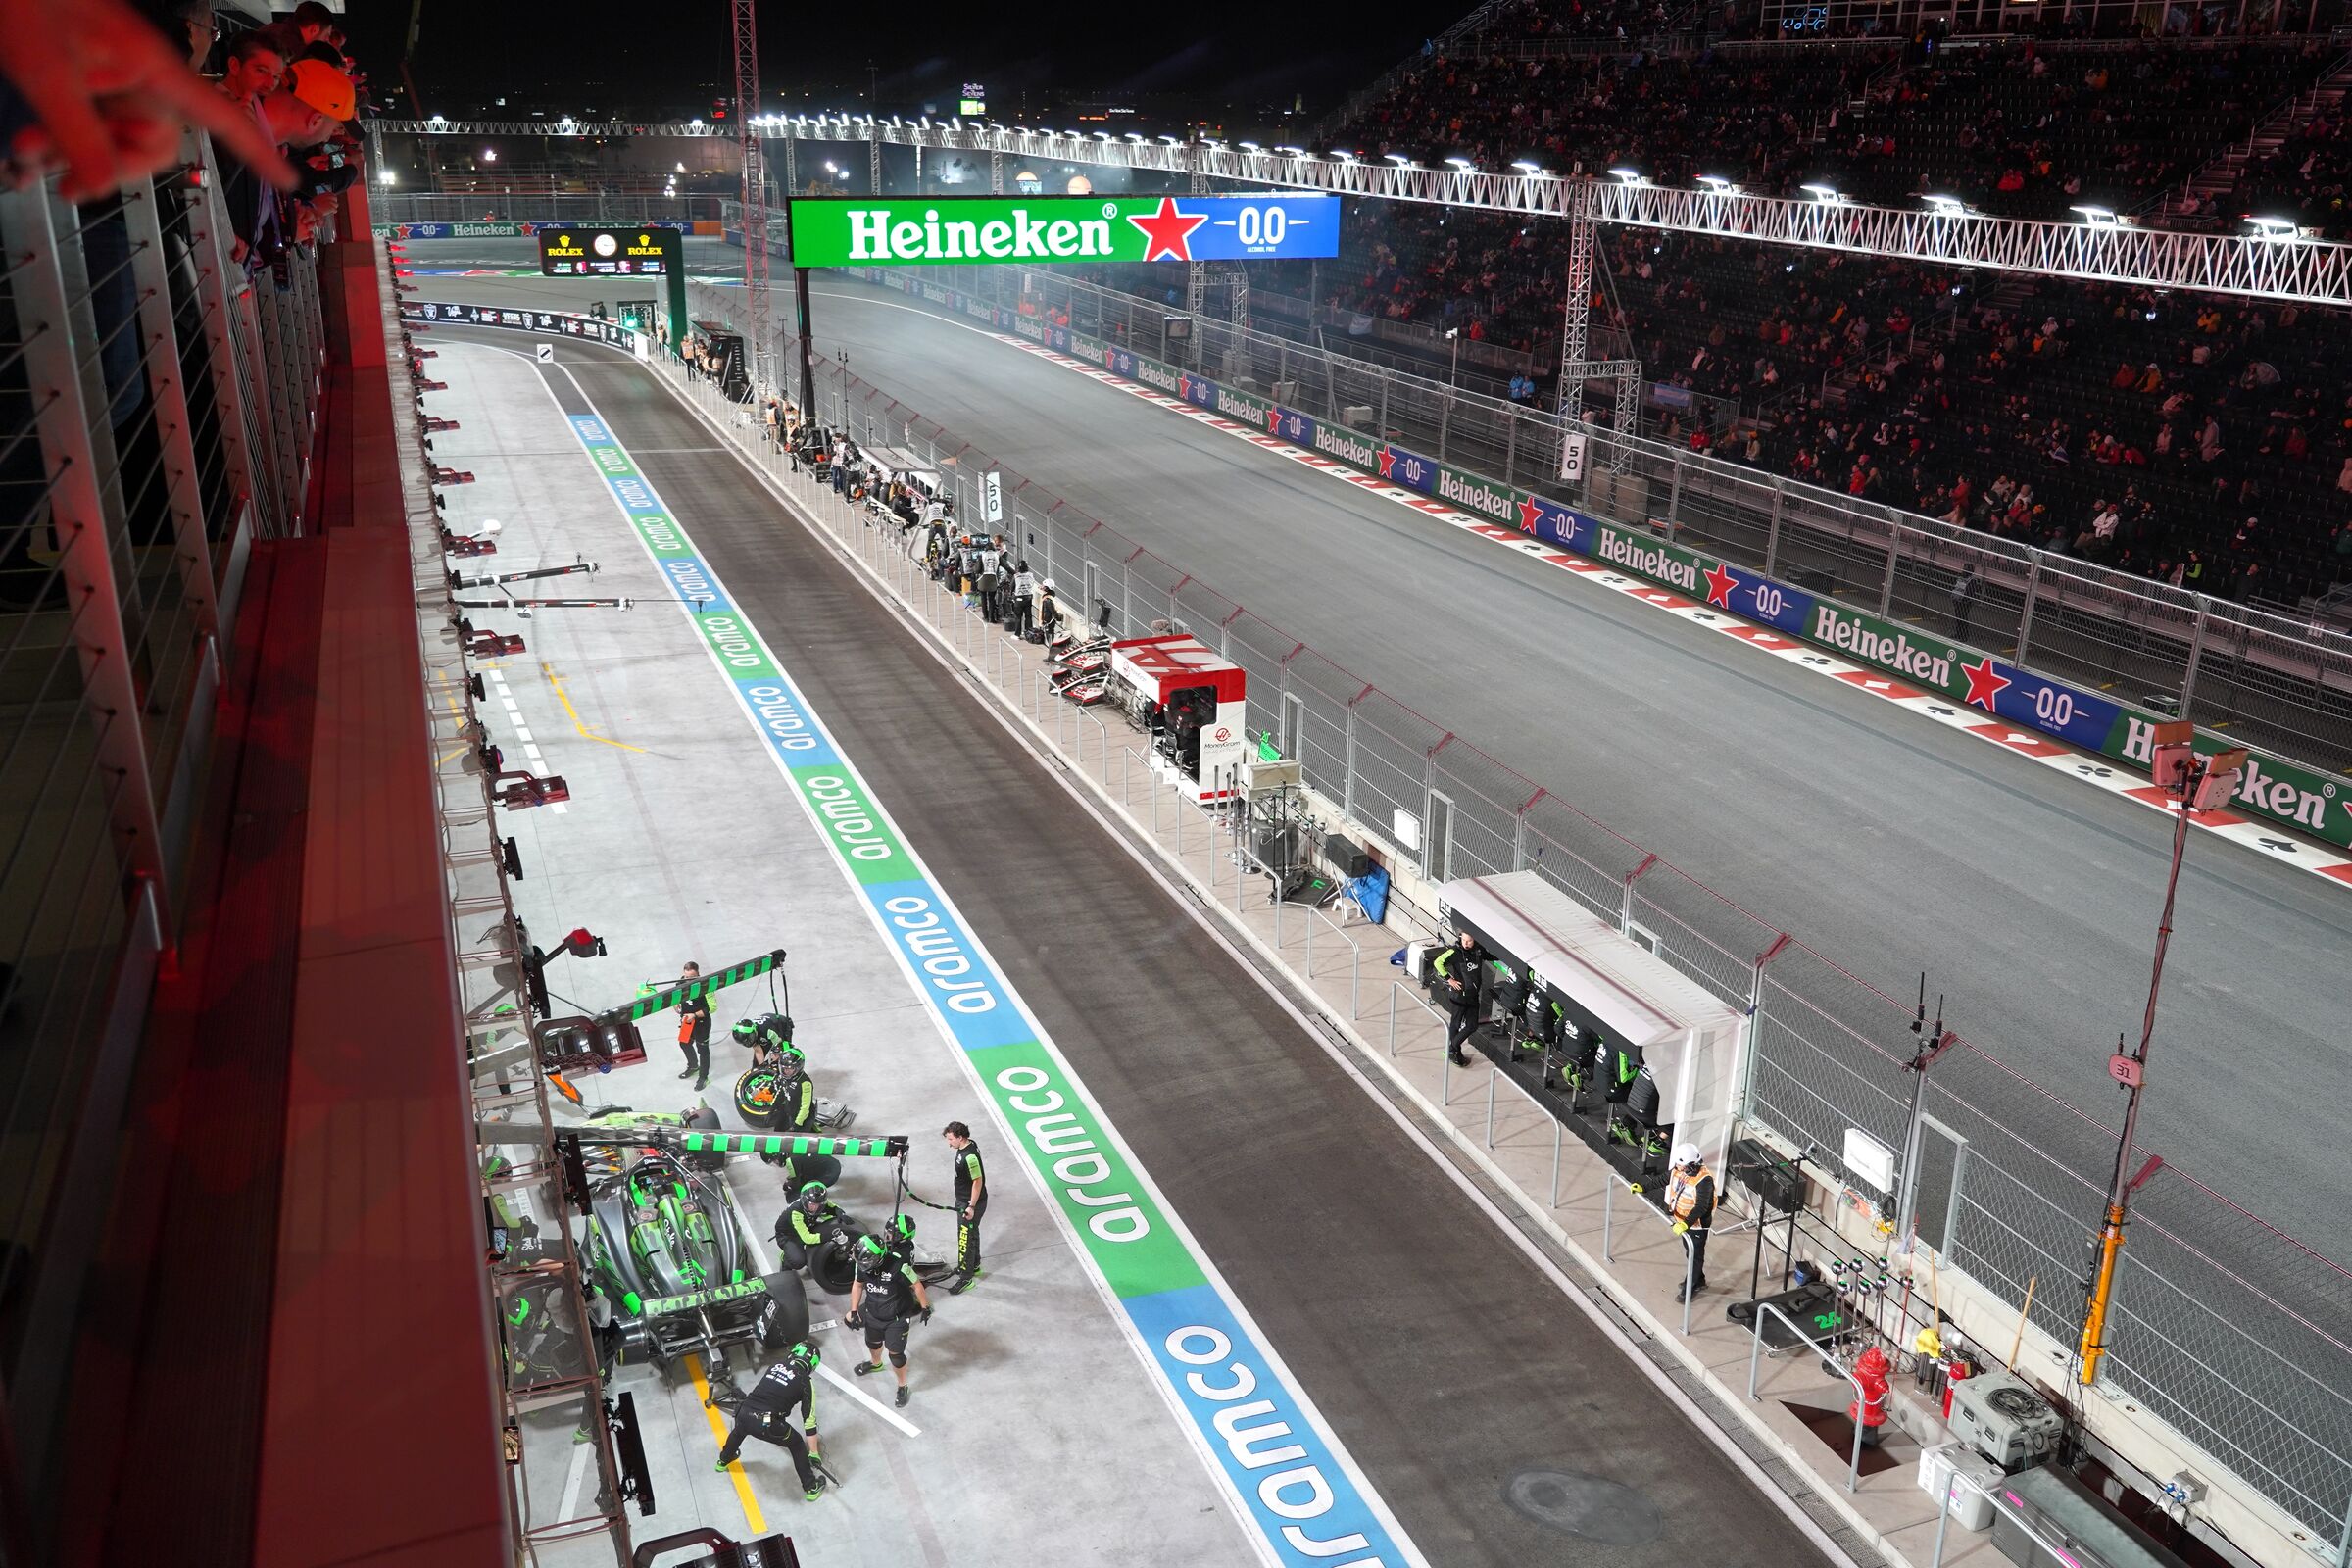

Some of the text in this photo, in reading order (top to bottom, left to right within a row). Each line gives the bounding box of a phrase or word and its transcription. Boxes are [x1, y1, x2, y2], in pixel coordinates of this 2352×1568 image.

[453, 224, 515, 237] Heineken
[847, 206, 1286, 259] Heineken 0.0
[547, 248, 584, 257] ROLEX
[627, 247, 663, 256] ROLEX
[1014, 316, 1043, 341] Heineken
[1071, 335, 1103, 365] Heineken
[1138, 360, 1207, 400] Heineken 0.0
[1218, 390, 1301, 436] Heineken 0.0
[595, 448, 628, 472] aramco
[1315, 424, 1420, 482] Heineken 0.0
[1567, 446, 1580, 470] 50
[614, 479, 652, 508] aramco
[989, 484, 999, 512] 50
[1439, 470, 1575, 539] Heineken 0.0
[639, 517, 681, 550] aramco
[667, 562, 716, 603] aramco
[1599, 527, 1782, 616] Heineken 0.0
[704, 617, 761, 667] aramco
[1814, 605, 2073, 725] Heineken 0.0
[749, 687, 817, 751] aramco
[806, 775, 893, 861] aramco
[885, 896, 997, 1014] aramco
[2117, 1063, 2131, 1079] 31
[996, 1066, 1151, 1243] aramco
[959, 1225, 968, 1253] CREW
[866, 1282, 888, 1295] Stake
[1814, 1311, 1842, 1329] 24
[770, 1363, 796, 1380] Stake
[1164, 1325, 1386, 1568] ramco
